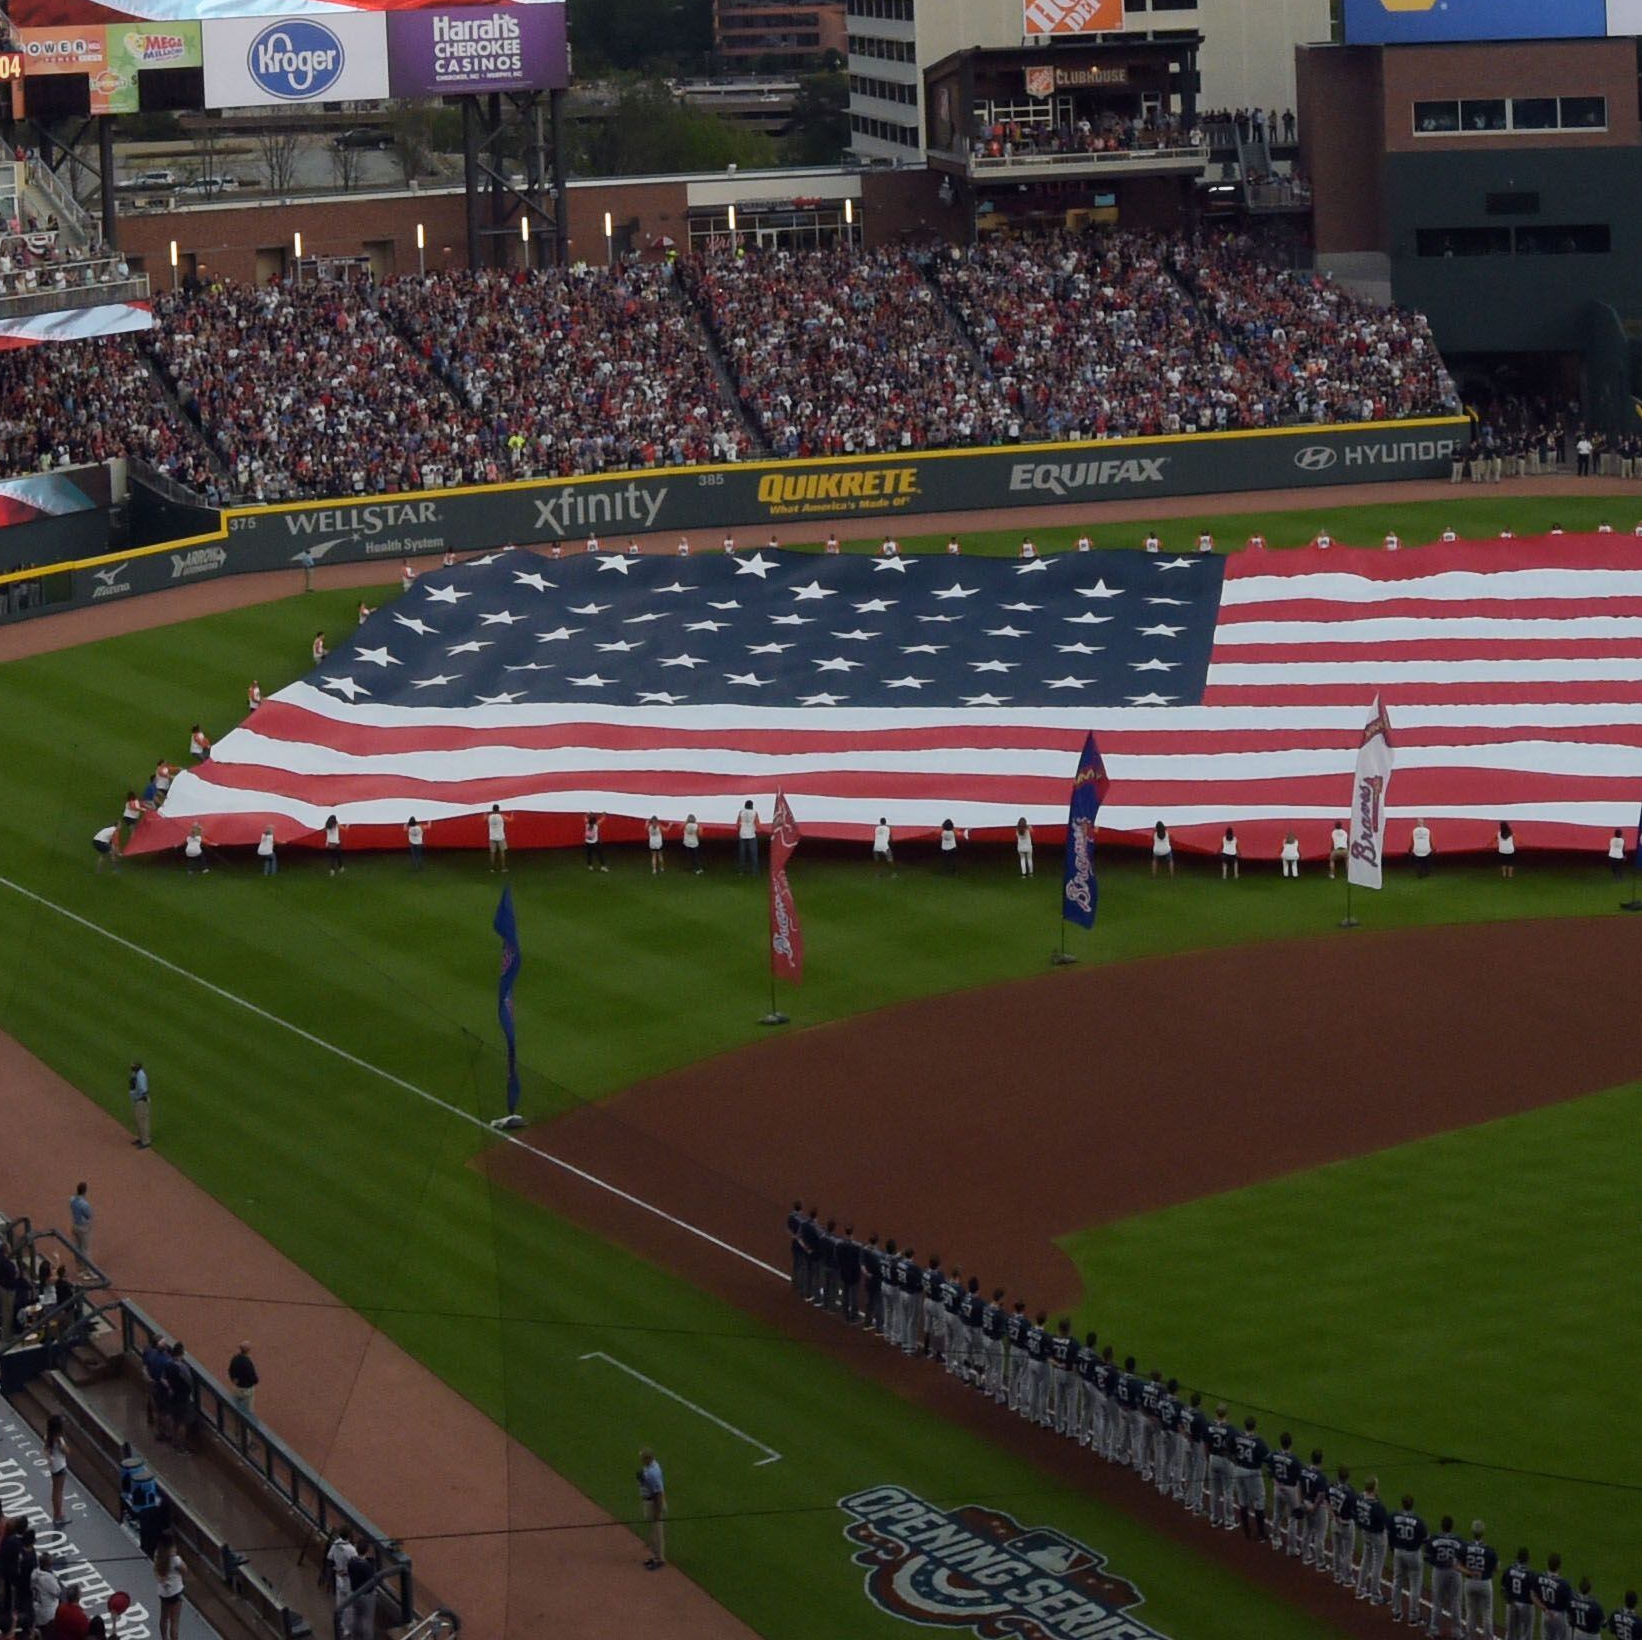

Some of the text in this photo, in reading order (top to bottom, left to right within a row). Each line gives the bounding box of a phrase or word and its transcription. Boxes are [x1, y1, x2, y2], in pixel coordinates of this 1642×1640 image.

[145, 36, 183, 50] MEGA
[434, 40, 520, 57] CHEROKEE
[259, 33, 336, 90] Kroger
[435, 56, 521, 73] CASINOS
[1057, 69, 1126, 84] CLUBHOUSE
[698, 474, 724, 487] 385
[758, 468, 918, 503] QUIKRETE
[1009, 458, 1165, 495] EQUIFAX
[534, 483, 667, 535] xfinity
[770, 503, 802, 514] What
[803, 501, 855, 513] America's
[858, 498, 889, 509] Made
[230, 517, 256, 530] 375
[285, 502, 437, 535] WELLSTAR
[366, 536, 444, 554] Health System
[1351, 782, 1377, 867] Braves
[848, 1490, 1033, 1586] OPENING
